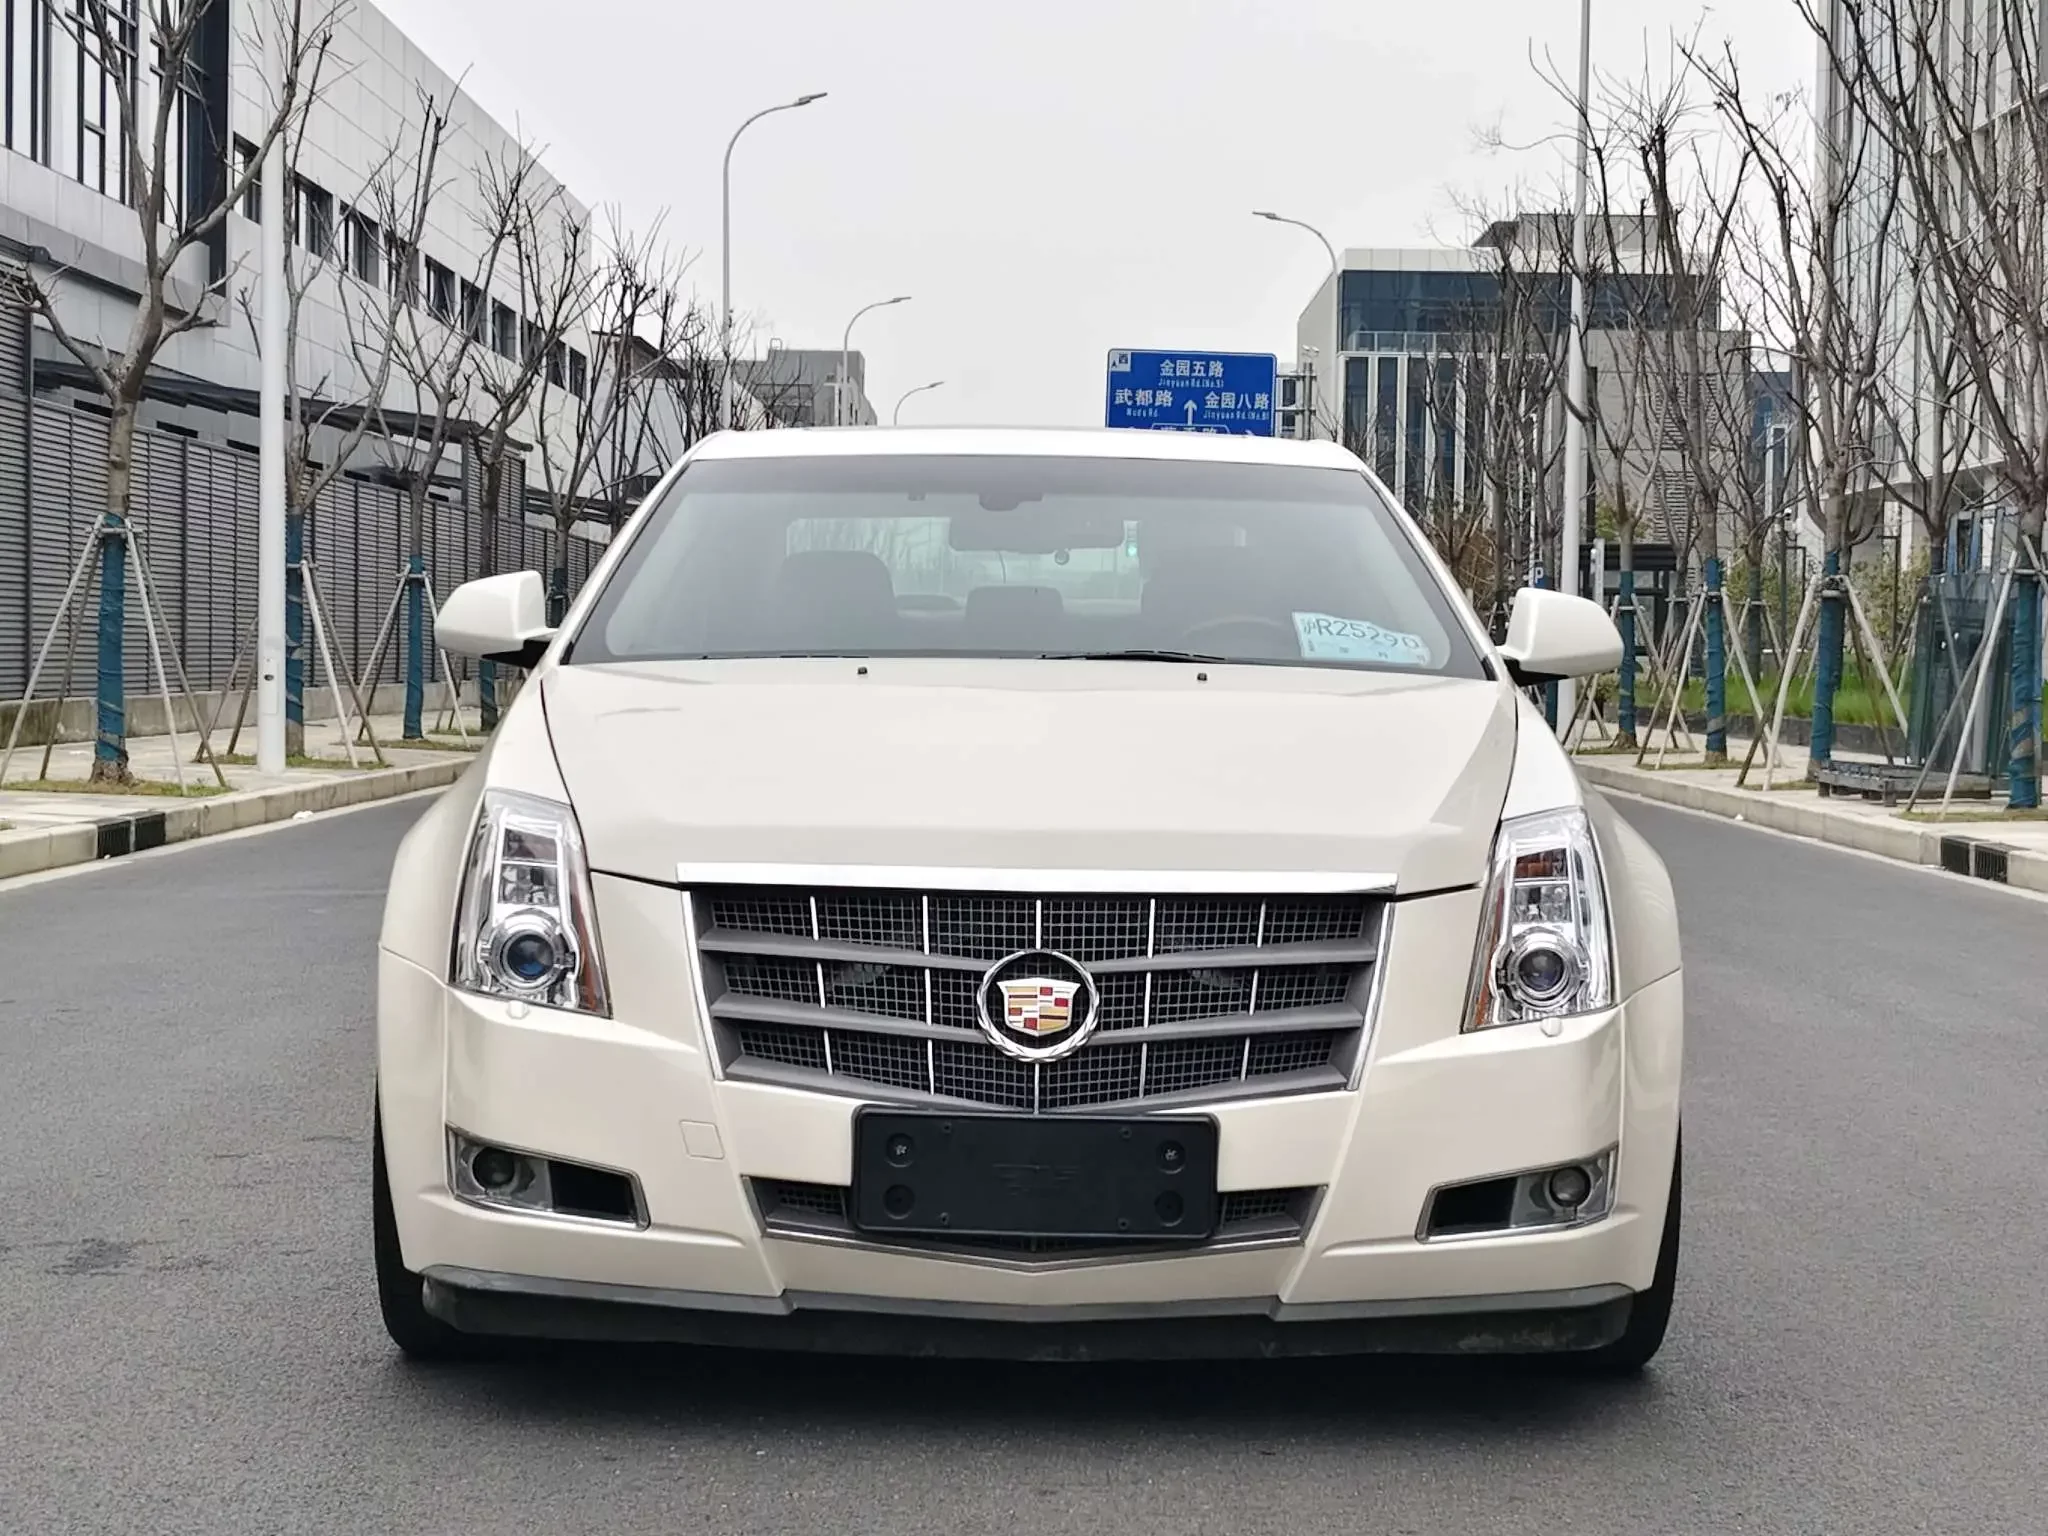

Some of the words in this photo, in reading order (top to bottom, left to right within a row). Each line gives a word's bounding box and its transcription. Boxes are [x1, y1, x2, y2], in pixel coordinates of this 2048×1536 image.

[1159, 359, 1224, 378] 金园五路
[1114, 388, 1173, 407] 武都路
[1204, 390, 1270, 410] 金园八路
